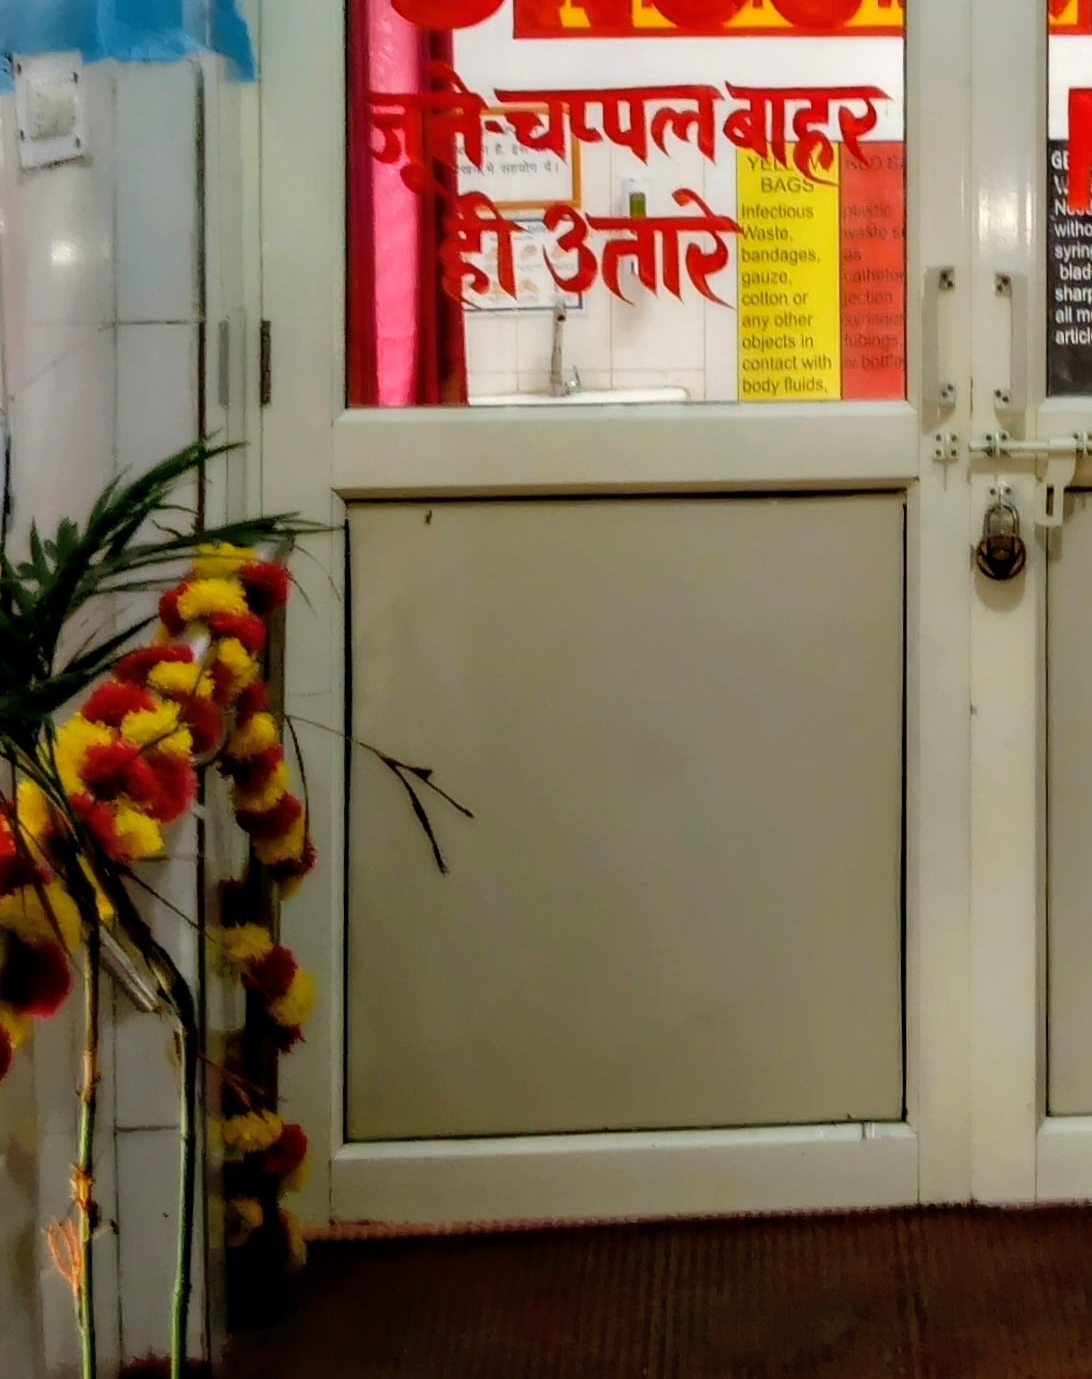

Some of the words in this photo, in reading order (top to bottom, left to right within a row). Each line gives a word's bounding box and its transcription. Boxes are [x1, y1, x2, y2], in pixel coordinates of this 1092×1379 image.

[760, 176, 815, 194] BAGS
[741, 203, 815, 220] Infectious
[742, 225, 793, 242] Waste,
[741, 247, 821, 267] bandages,
[741, 291, 789, 307] cotton
[792, 292, 809, 306] or
[741, 315, 770, 332] any
[774, 312, 813, 328] other
[1054, 305, 1073, 324] all
[741, 334, 797, 353] objects
[801, 334, 815, 349] in
[742, 356, 798, 371] contact
[801, 354, 833, 371] with
[742, 376, 780, 395] body
